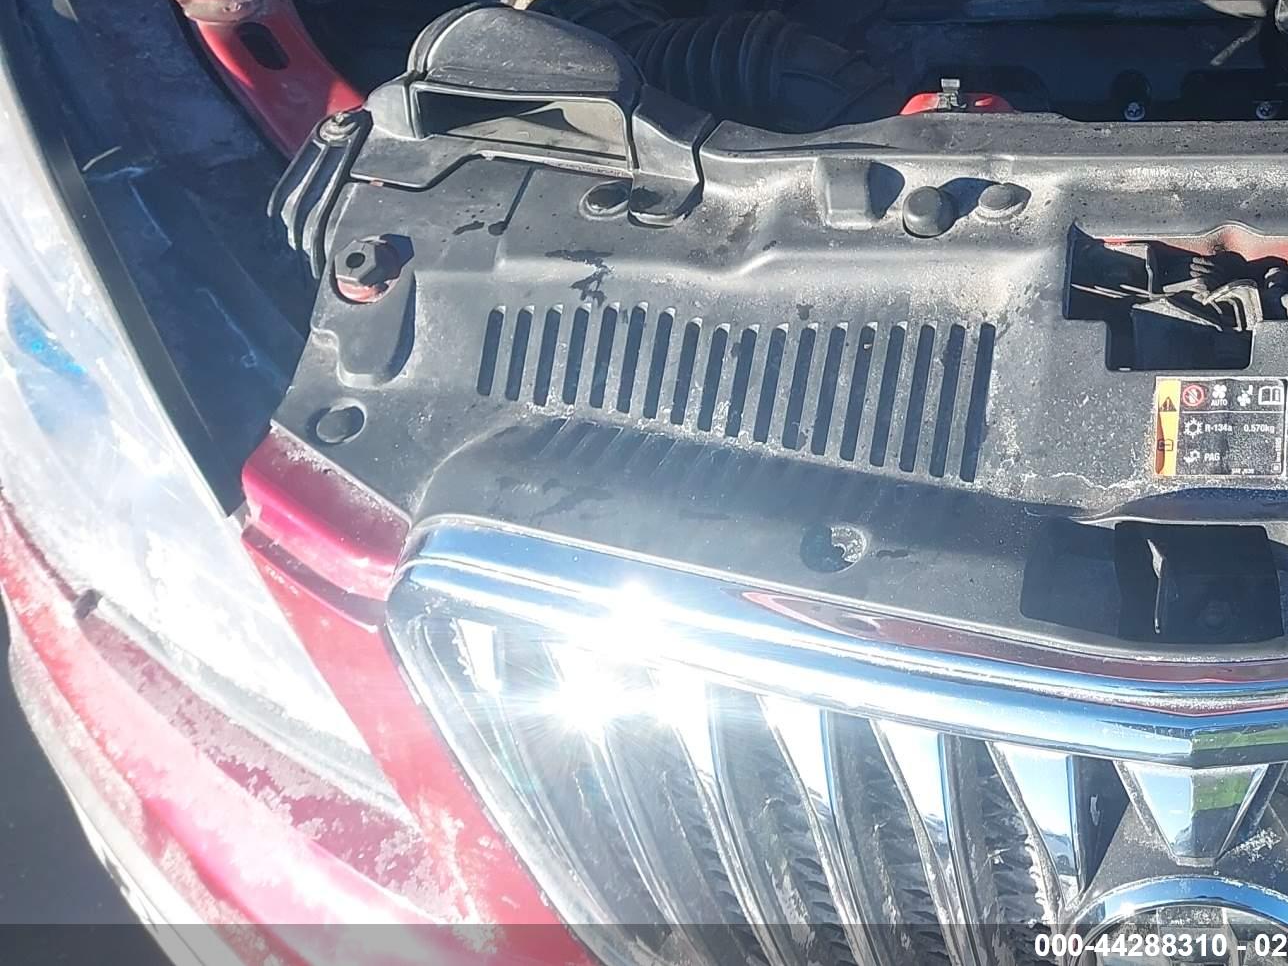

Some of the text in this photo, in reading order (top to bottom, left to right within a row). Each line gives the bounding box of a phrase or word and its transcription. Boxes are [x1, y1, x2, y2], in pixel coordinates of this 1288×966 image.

[1204, 423, 1275, 434] R-134a 0.570kg
[1204, 452, 1220, 461] PAG
